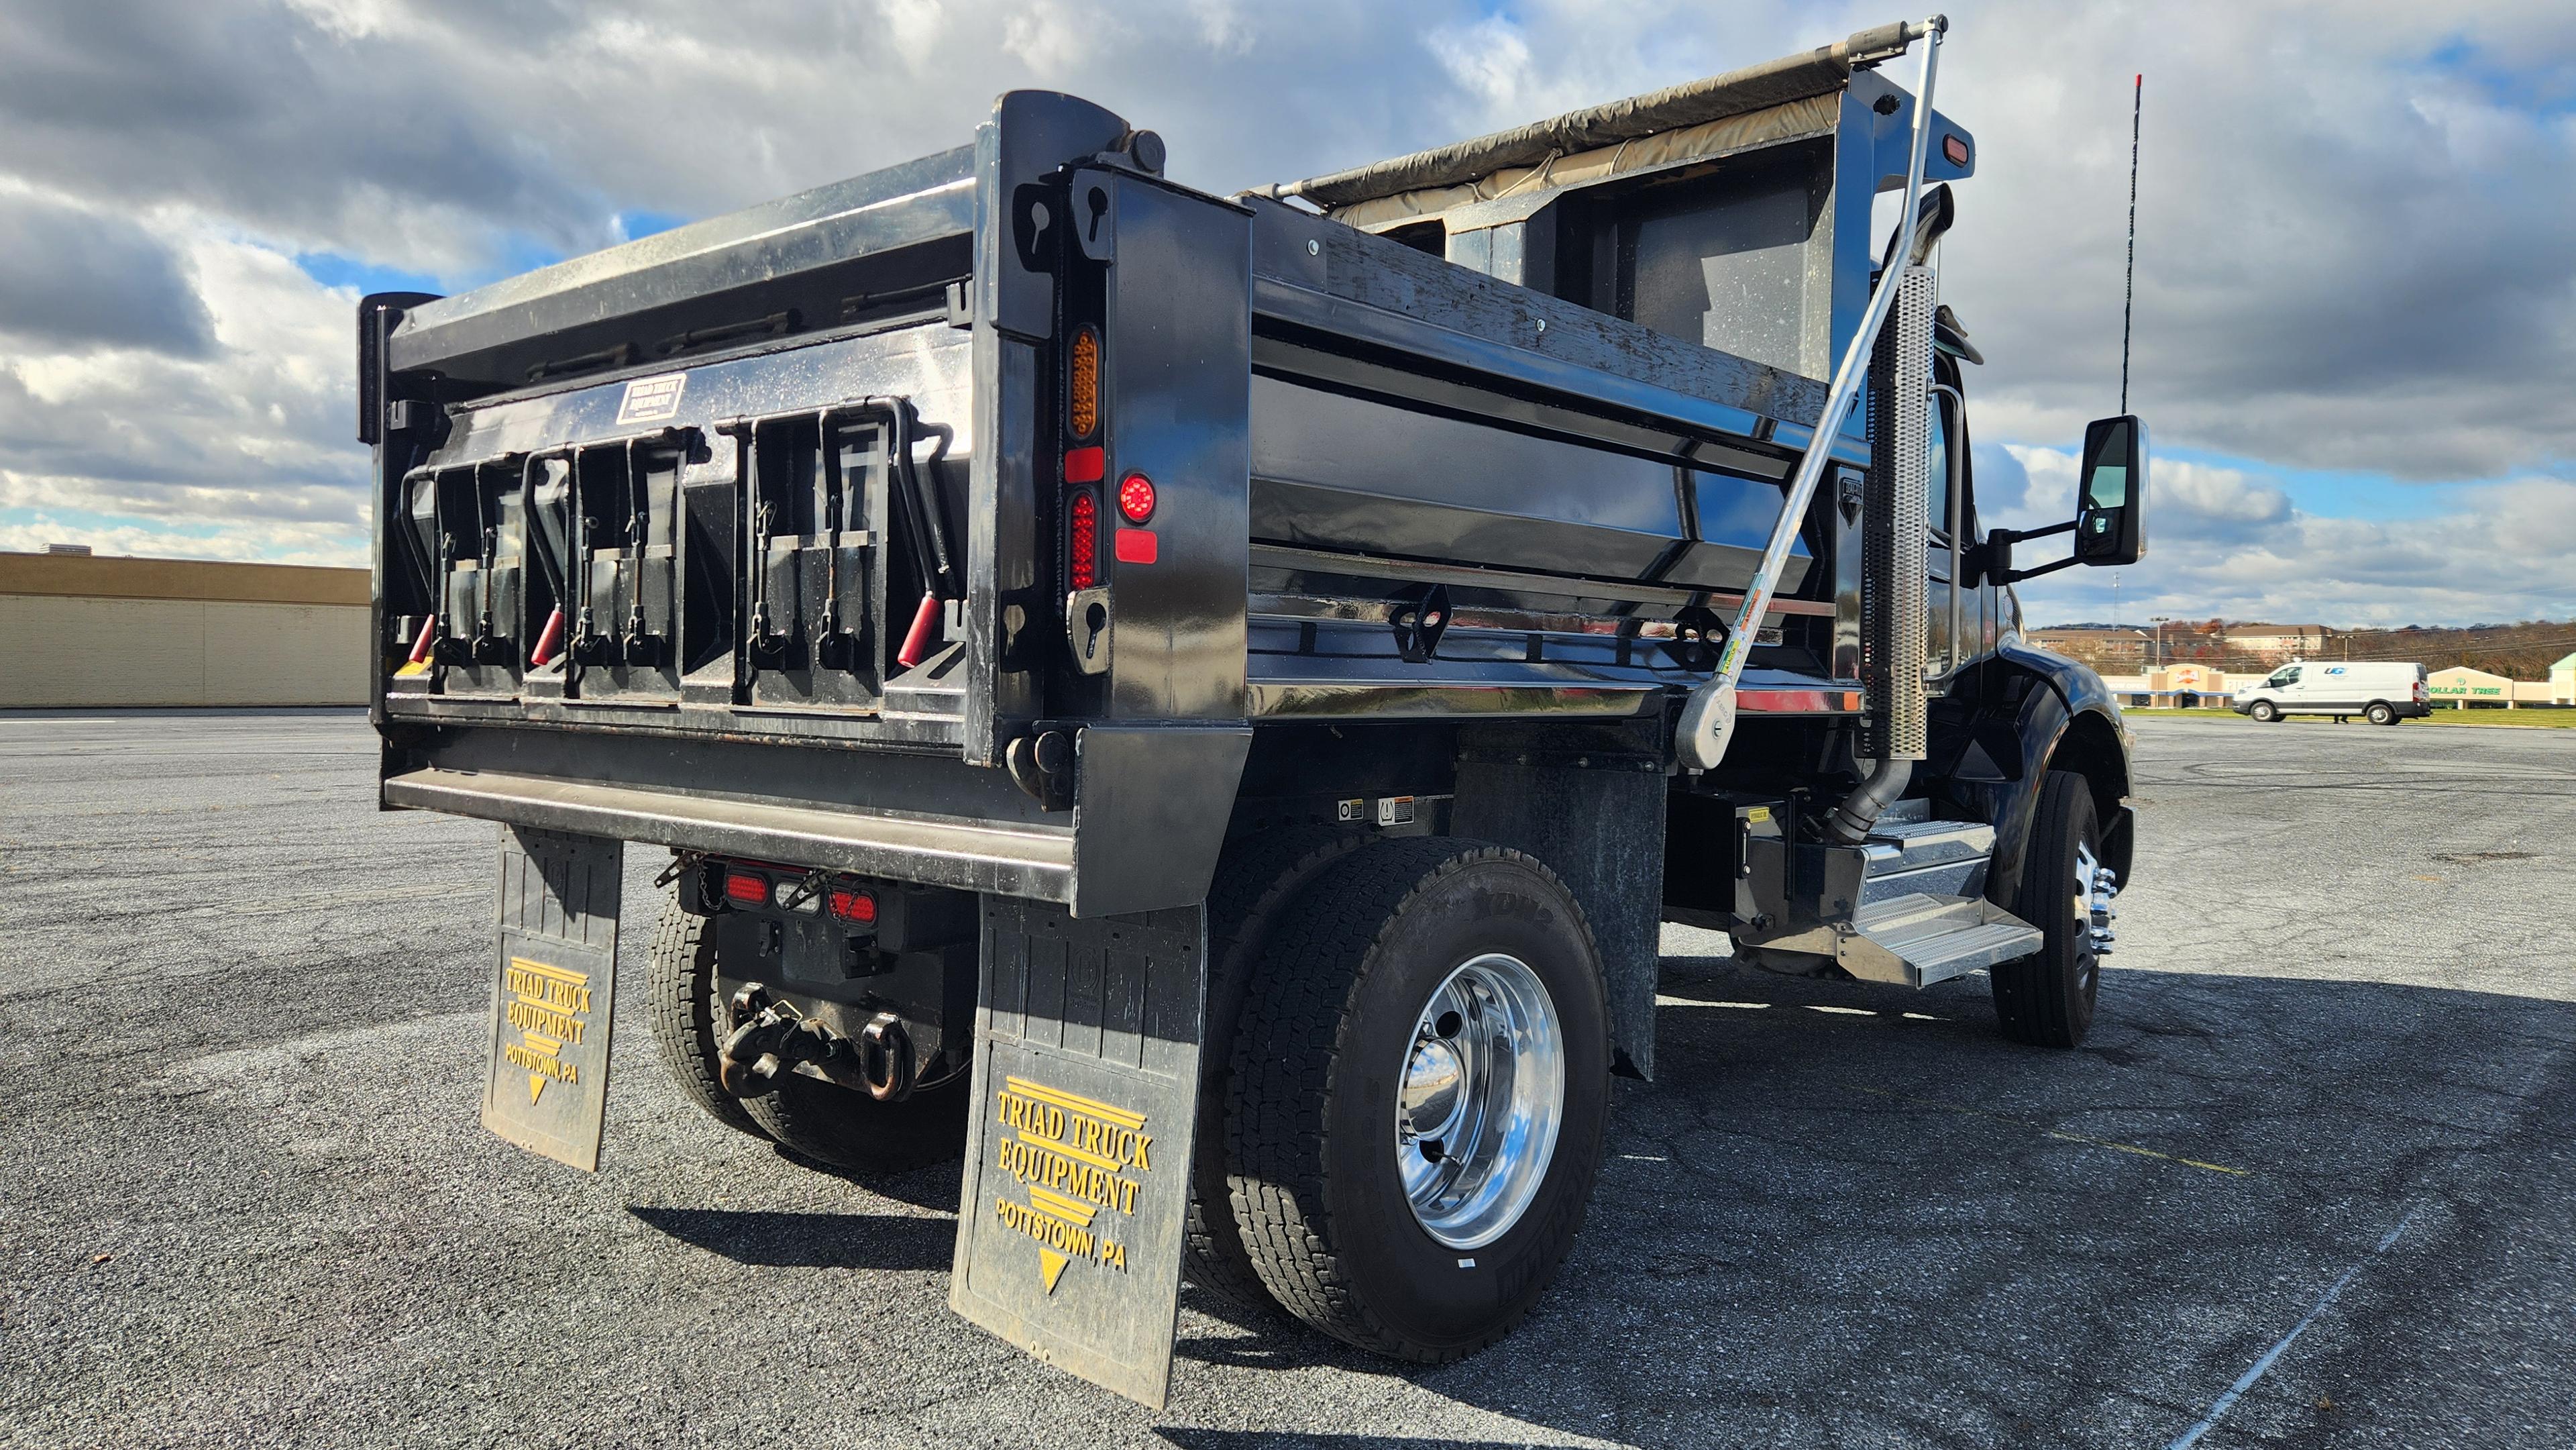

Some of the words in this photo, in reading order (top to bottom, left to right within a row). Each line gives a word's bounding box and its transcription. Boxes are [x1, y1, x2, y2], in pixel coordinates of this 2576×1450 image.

[2471, 687, 2502, 695] TREE
[506, 968, 544, 1000] TRIAD
[547, 978, 592, 1013] TRUCK
[507, 1000, 586, 1045] EQUIPMENT
[506, 1043, 561, 1082] POTTSTOWN,
[563, 1063, 578, 1085] PA
[998, 1090, 1065, 1140] TRIAD
[1071, 1113, 1153, 1171] TRUCK
[998, 1137, 1140, 1216] EQUIPMENT
[996, 1198, 1098, 1267] POTTSTOWN,
[1102, 1239, 1127, 1274] PA
